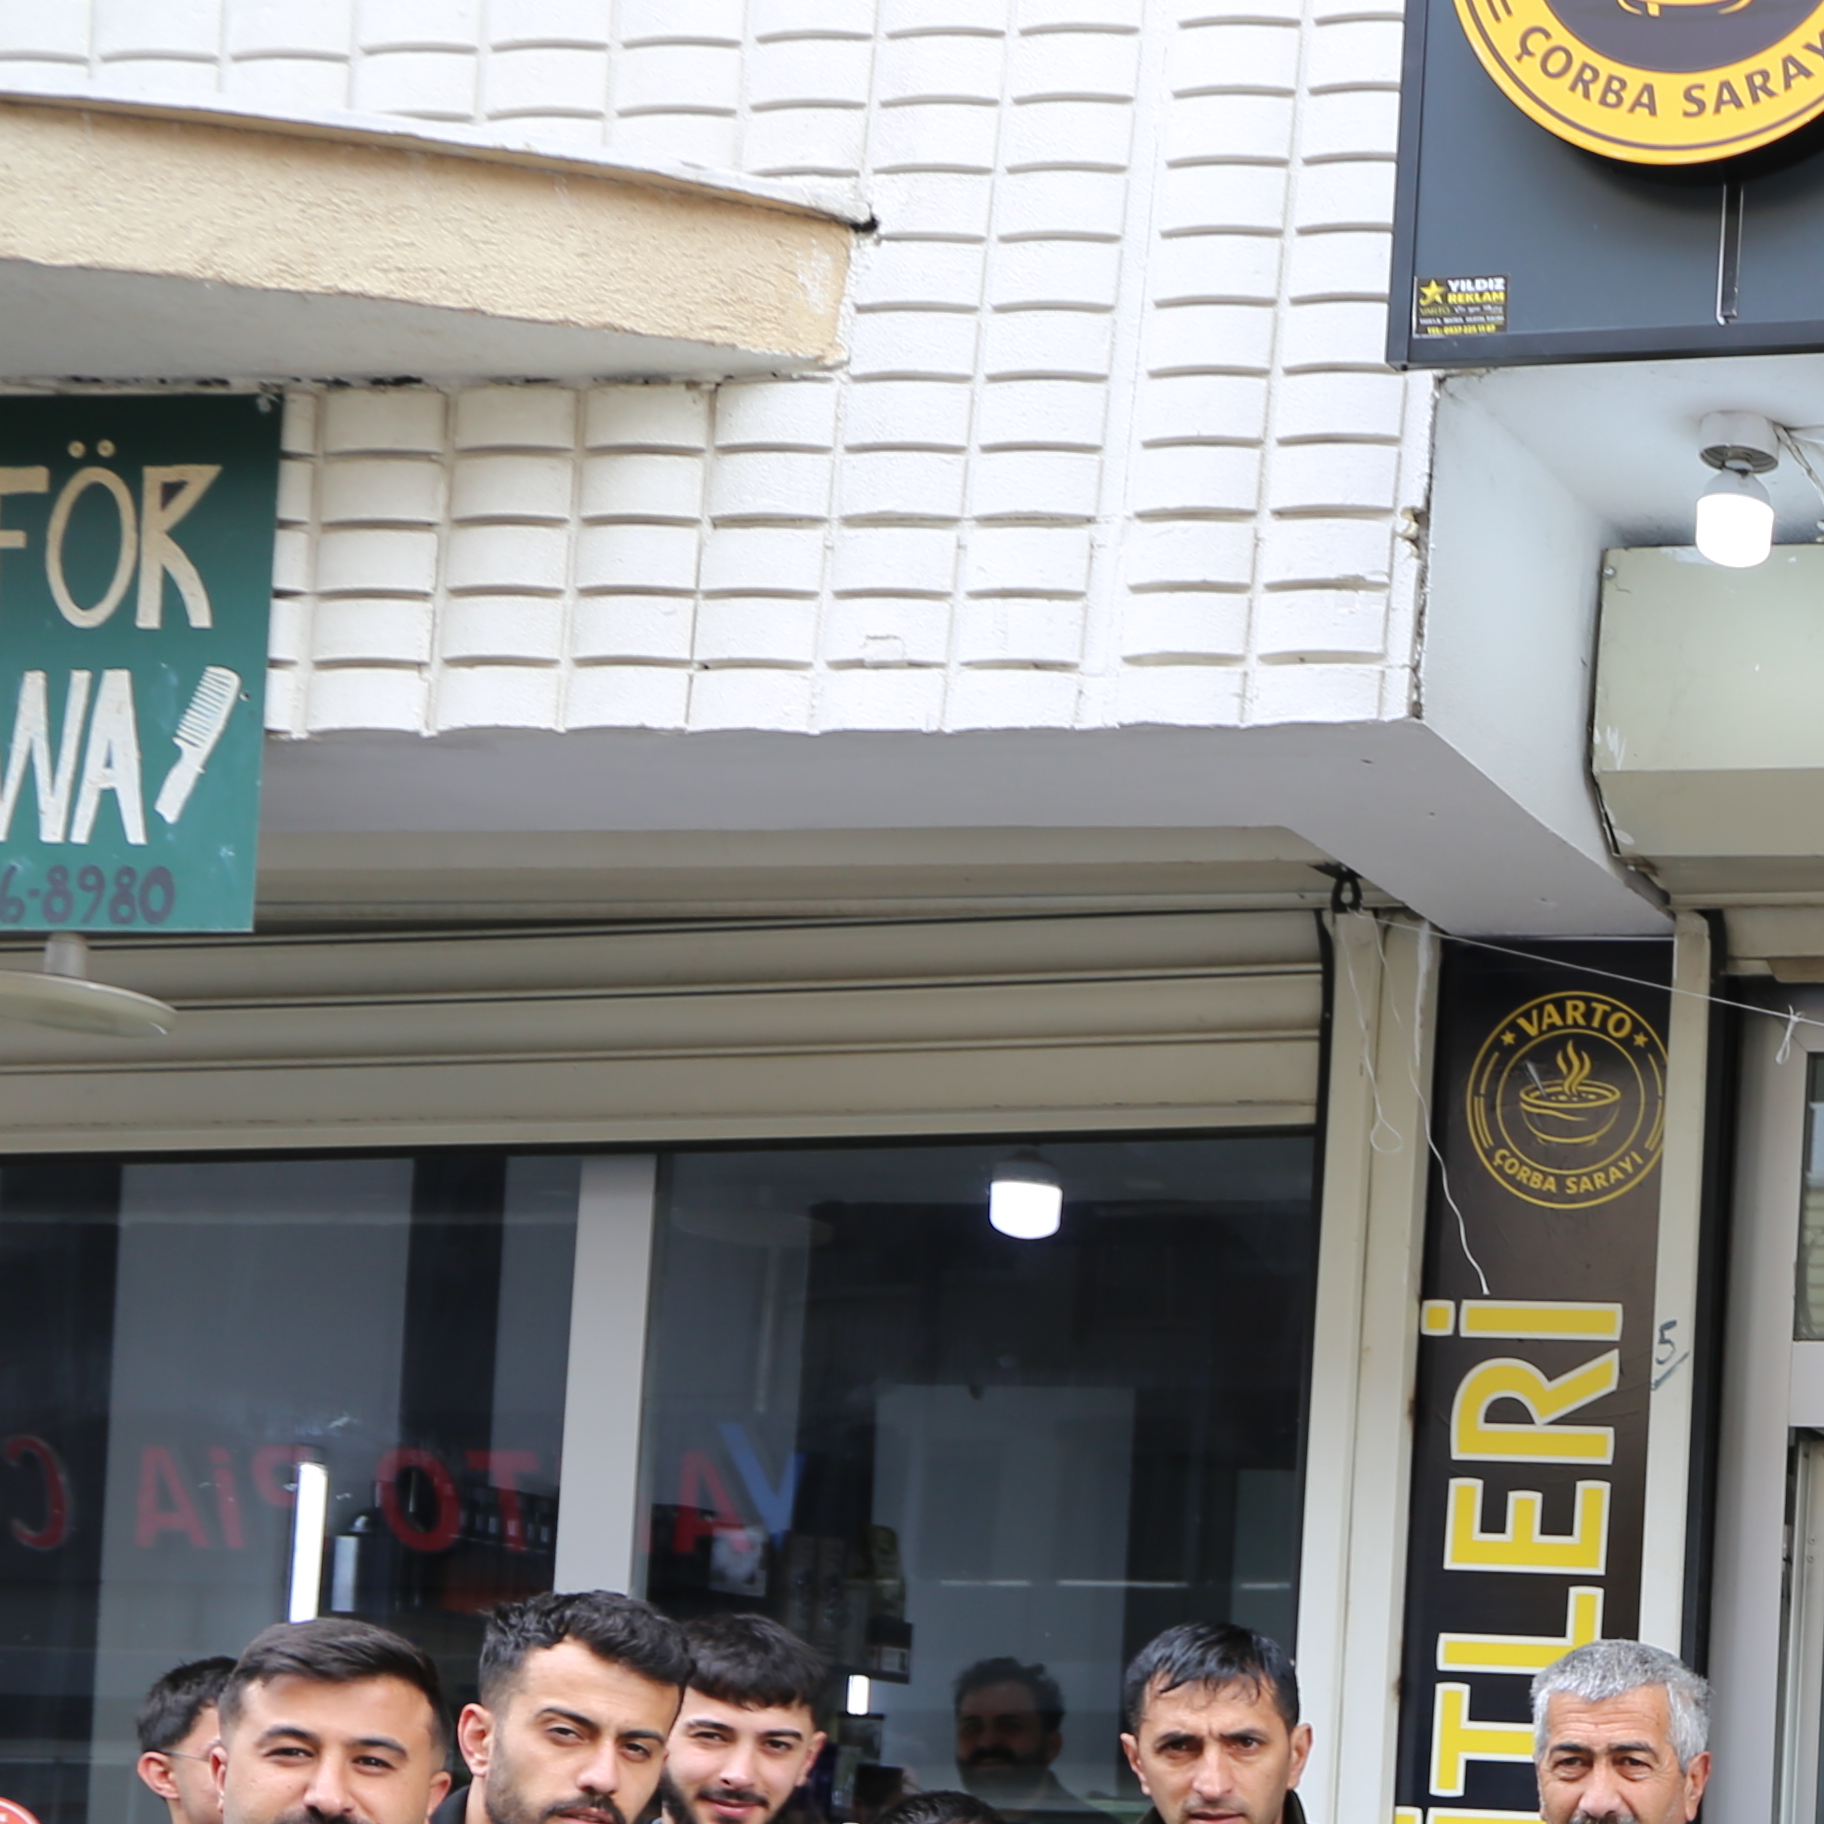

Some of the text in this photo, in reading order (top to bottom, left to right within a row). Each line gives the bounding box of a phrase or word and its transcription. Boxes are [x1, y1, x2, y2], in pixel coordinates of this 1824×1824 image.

[1514, 25, 1659, 118] ÇORBA
[1447, 277, 1505, 292] YILDIZ
[1447, 291, 1505, 304] REKLAM
[1516, 1000, 1632, 1038] VARTO
[1493, 1148, 1644, 1194] ÇORBA SARAYI
[1655, 1319, 1678, 1365] 5
